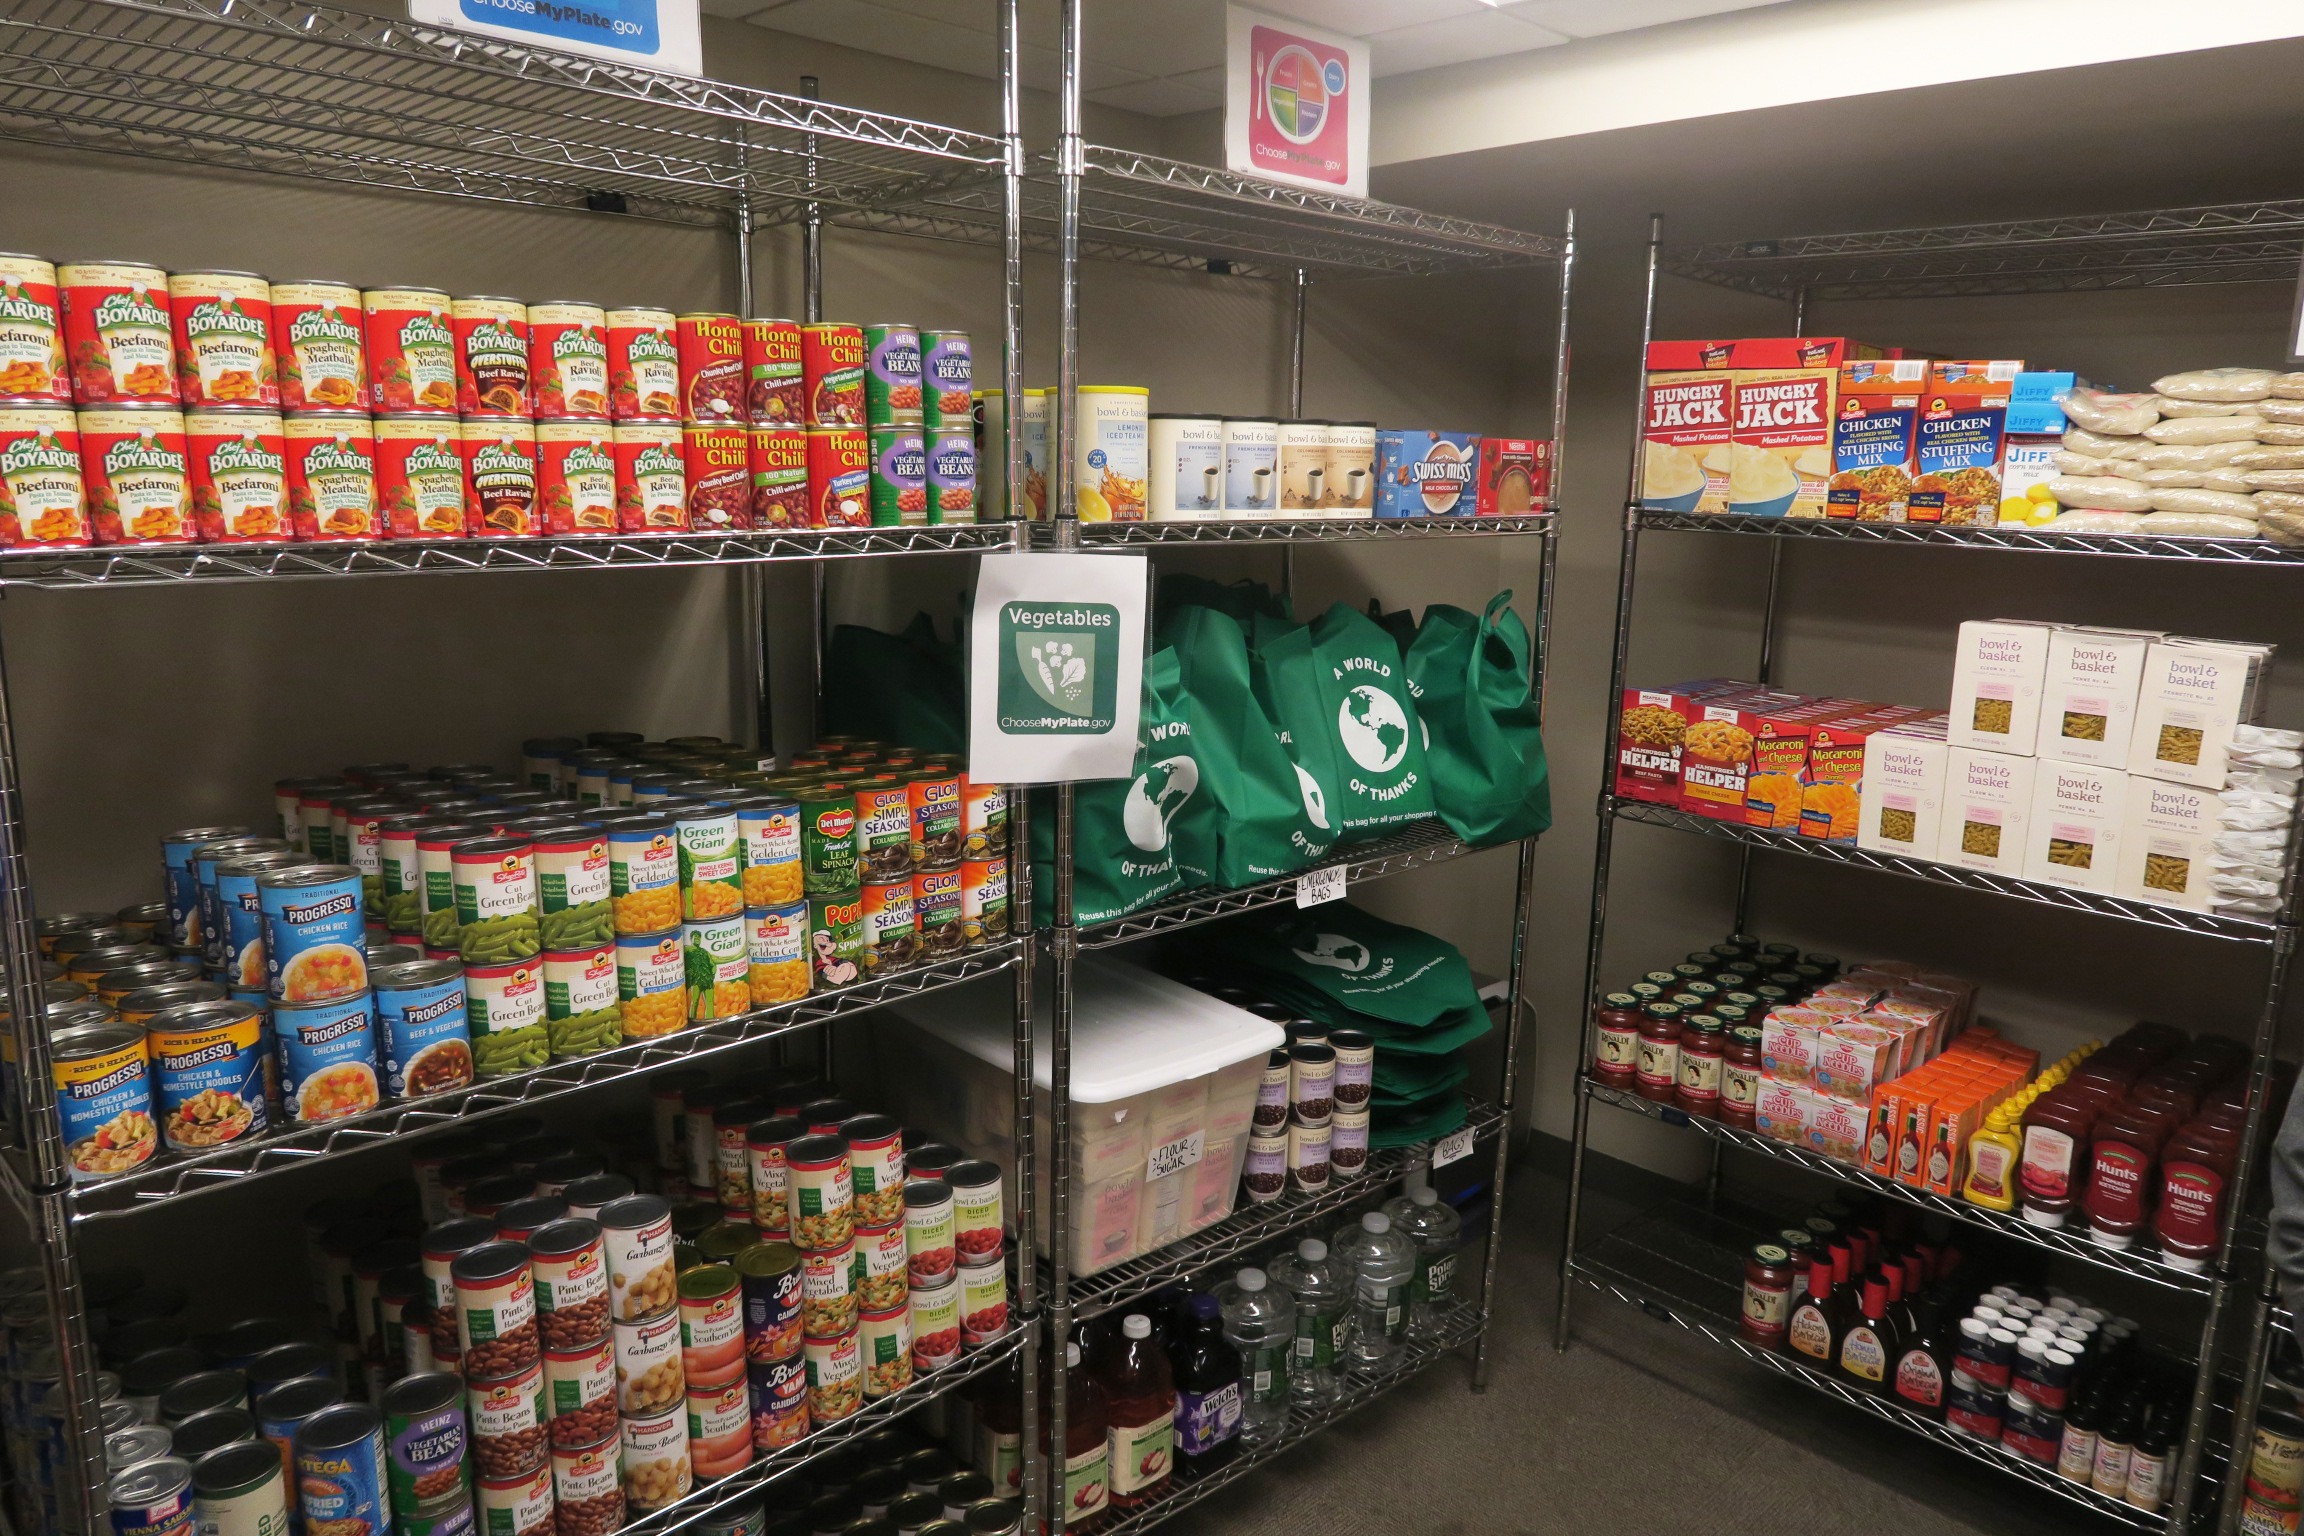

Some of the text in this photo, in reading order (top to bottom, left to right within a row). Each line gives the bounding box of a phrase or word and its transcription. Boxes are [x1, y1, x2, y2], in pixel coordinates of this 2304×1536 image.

[474, 0, 643, 36] ooseMyPlate.gov
[103, 294, 129, 309] Chef
[96, 306, 171, 328] BOYARDEE
[187, 316, 265, 337] BOYARDEE
[290, 324, 361, 345] BOYARDEE
[896, 334, 916, 346] HEINZ
[110, 336, 169, 350] Beefaroni
[199, 343, 258, 357] Beefaroni
[304, 343, 345, 356] Spaghetti
[946, 342, 967, 352] HEINZ
[766, 344, 800, 360] Chili
[308, 354, 354, 365] Meatballs
[888, 360, 921, 372] BEANS
[479, 369, 525, 379] Beef Ravioli
[570, 366, 602, 377] Ravioli
[645, 369, 674, 379] Ravioli
[701, 368, 723, 378] Chunky
[1654, 384, 1723, 403] HUNGRY
[1740, 383, 1818, 403] HUNGRY
[1097, 407, 1119, 416] bowl
[1650, 400, 1725, 427] JACK
[1736, 399, 1820, 428] JACK
[1840, 417, 1902, 433] CHICKEN
[1923, 417, 1991, 433] CHICKEN
[2010, 416, 2044, 426] JIFFY
[1183, 430, 1205, 439] bowl
[1232, 432, 1254, 441] bowl
[1673, 433, 1728, 442] Mashed Potatoes
[1762, 435, 1823, 444] Mashed Potatoes
[947, 439, 968, 449] HEINZ
[1839, 441, 1903, 456] STUFFING
[1922, 442, 1992, 458] STUFFING
[1, 453, 82, 475] BOYARDEE
[105, 453, 184, 475] BOYARDEE
[209, 454, 283, 475] BOYARDEE
[707, 450, 745, 465] Chili
[768, 451, 805, 466] Chili
[1857, 454, 1884, 466] MIX
[1943, 456, 1971, 467] MIX
[1412, 462, 1472, 482] SWISS MISS
[2029, 463, 2056, 471] muffin
[16, 481, 78, 495] Beefaroni
[119, 480, 180, 494] Beefaroni
[222, 480, 278, 493] Beefaroni
[484, 490, 531, 499] Beef Ravioli
[1008, 608, 1111, 628] Vegetables
[1980, 638, 2009, 649] bowl
[1979, 650, 2021, 663] basket
[2073, 648, 2104, 660] bowl
[1333, 657, 1391, 680] A WORLD
[2071, 659, 2114, 673] basket
[2171, 661, 2204, 675] bowl
[2168, 673, 2216, 689] basket
[1001, 717, 1111, 729] ChooseMyPlate.gov
[1631, 747, 1669, 757] HAMBURGER
[1757, 740, 1803, 750] Macaroni
[1621, 750, 1680, 772] HELPER
[1768, 752, 1802, 763] Cheese
[1813, 749, 1862, 760] Macaroni
[1825, 762, 1861, 773] Cheese
[1685, 767, 1745, 791] HELPER
[1967, 772, 2010, 789] basket
[1350, 772, 1418, 801] OF THANKS
[875, 792, 906, 807] GLORY
[2056, 787, 2100, 804] basket
[874, 806, 909, 822] SIMPLY
[1355, 818, 1368, 827] bag
[1380, 815, 1388, 823] all
[1389, 815, 1403, 823] your
[1405, 811, 1432, 820] shopping
[820, 816, 853, 828] Del Monte
[684, 825, 724, 839] Green
[693, 837, 725, 850] Giant
[873, 835, 897, 845] COLLARD
[830, 851, 849, 860] LEAF
[823, 858, 854, 868] SPINACH
[631, 872, 666, 884] Golden
[716, 867, 735, 875] CORN
[923, 874, 960, 893] GLORY
[1301, 869, 1339, 891] EMERGENCY
[302, 889, 340, 898] TRADITIONAL
[505, 885, 522, 895] Cut
[1312, 887, 1330, 903] BAGS
[481, 895, 514, 909] Green
[289, 897, 351, 923] PROGRESSO
[1078, 908, 1121, 921] Reuse this
[298, 922, 348, 936] CHICKEN RICE
[705, 926, 741, 940] Green
[718, 937, 742, 951] Giant
[639, 977, 673, 988] Golden
[573, 990, 606, 1003] Green
[409, 993, 462, 1022] PROGRESSO
[492, 1009, 525, 1022] Green
[304, 1015, 365, 1044] PROGRESSO
[409, 1018, 465, 1039] BEEF VEGETABLE
[347, 1039, 361, 1048] RICE
[1778, 1036, 1801, 1048] CUP
[165, 1044, 232, 1069] PROGRESSO
[1768, 1041, 1808, 1060] NOODLES
[1834, 1050, 1858, 1063] CUP
[74, 1052, 138, 1073] RICH HEARTY
[1823, 1056, 1864, 1077] NOODLES
[75, 1061, 142, 1098] PROGRESSO
[1772, 1096, 1796, 1108] CUP
[1948, 1113, 1958, 1144] CLASSIC
[1158, 1139, 1188, 1161] FLOUR
[1442, 1136, 1465, 1159] BAGS
[1156, 1156, 1185, 1176] SUGAR
[922, 1226, 944, 1236] DICED
[626, 1243, 665, 1261] Garbanzo
[558, 1281, 580, 1296] Pinto
[807, 1276, 835, 1287] Mixed
[693, 1331, 728, 1343] Southern
[628, 1340, 667, 1356] Garbanzo
[782, 1376, 805, 1394] YAMS
[771, 1397, 800, 1410] CANDIED
[476, 1408, 531, 1424] Pinto Beans
[421, 1414, 451, 1433] HEINZ
[637, 1421, 673, 1434] HANOVER
[408, 1425, 460, 1449] VEGETARIAN
[412, 1433, 461, 1462] BEANS
[562, 1478, 585, 1489] Pinto
[123, 1525, 160, 1536] VIENNA
